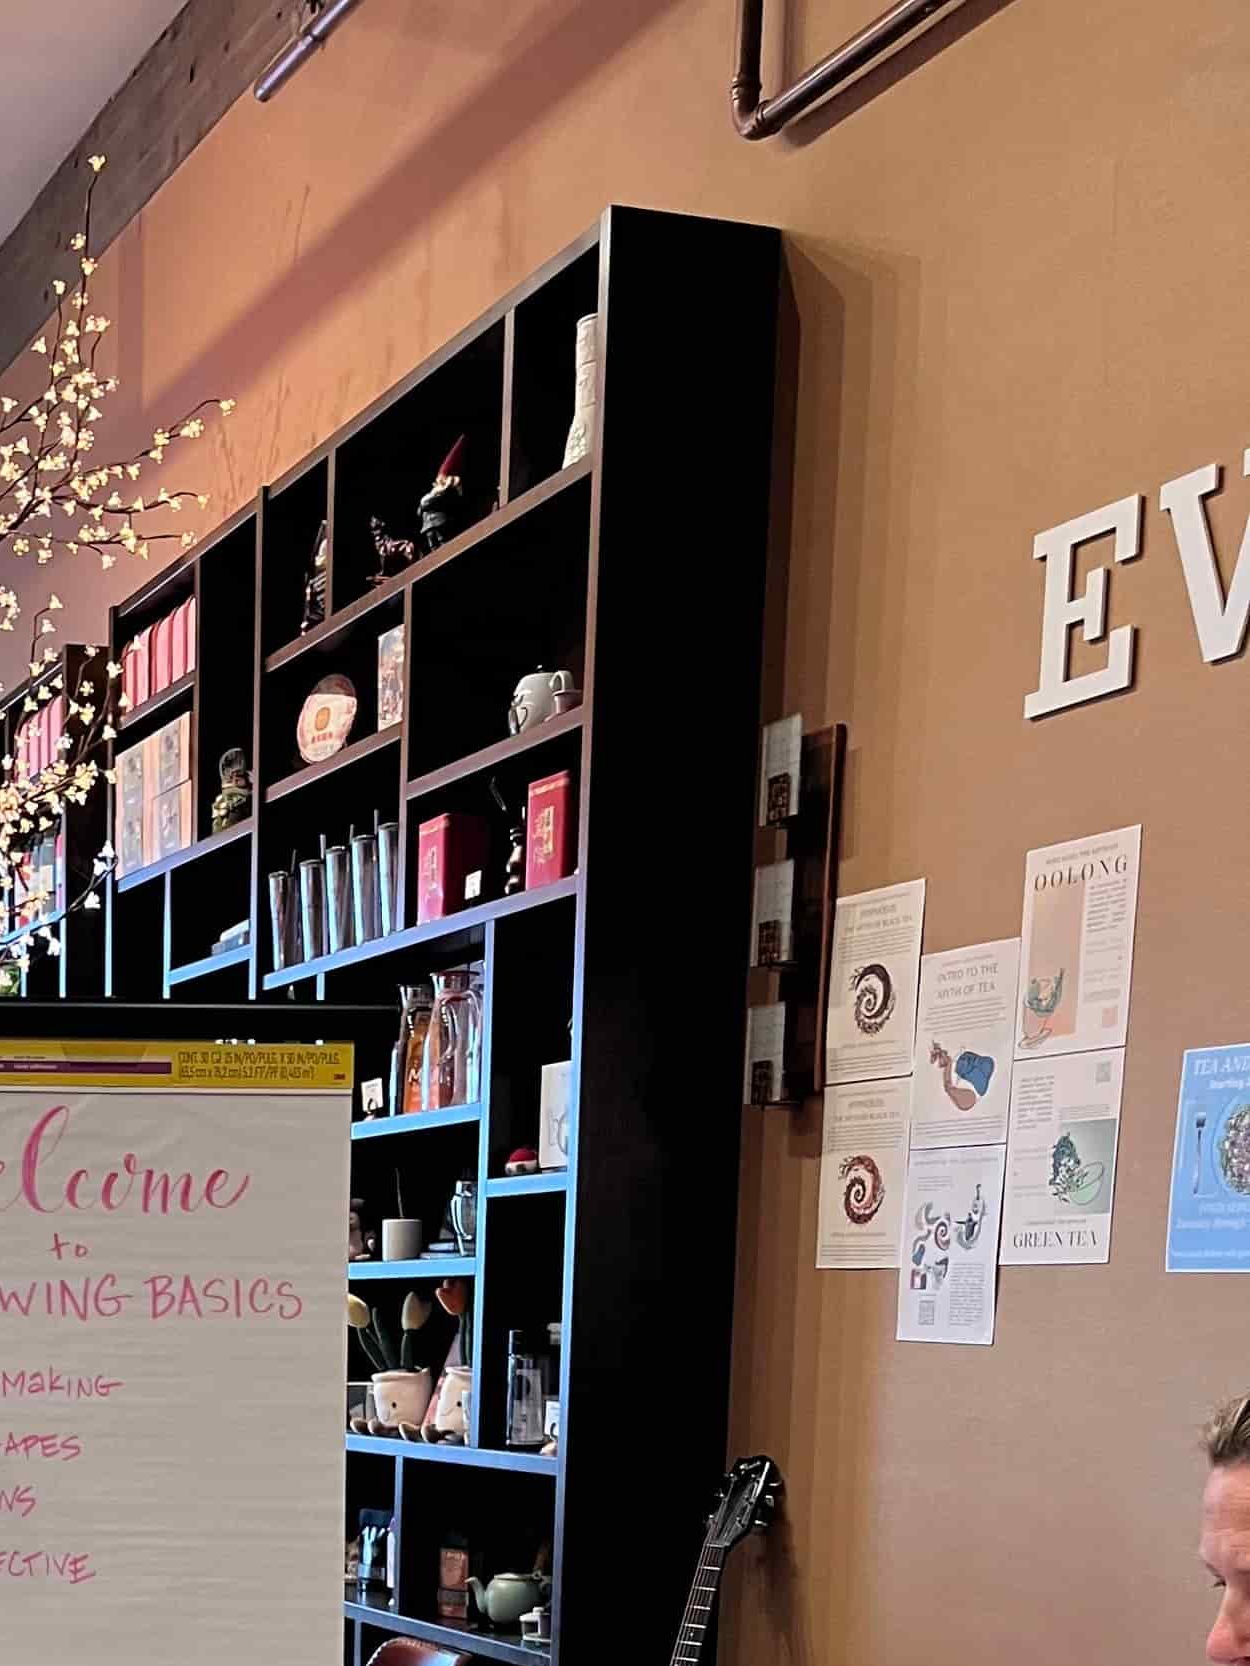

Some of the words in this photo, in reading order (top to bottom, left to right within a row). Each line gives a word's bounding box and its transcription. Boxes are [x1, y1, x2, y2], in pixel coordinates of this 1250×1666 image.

[1024, 463, 1250, 720] EV
[1034, 855, 1127, 891] OOLONG
[50, 1233, 89, 1259] to
[1013, 1231, 1064, 1248] GREEN
[1069, 1230, 1099, 1247] TEA
[143, 1276, 303, 1320] BASICS
